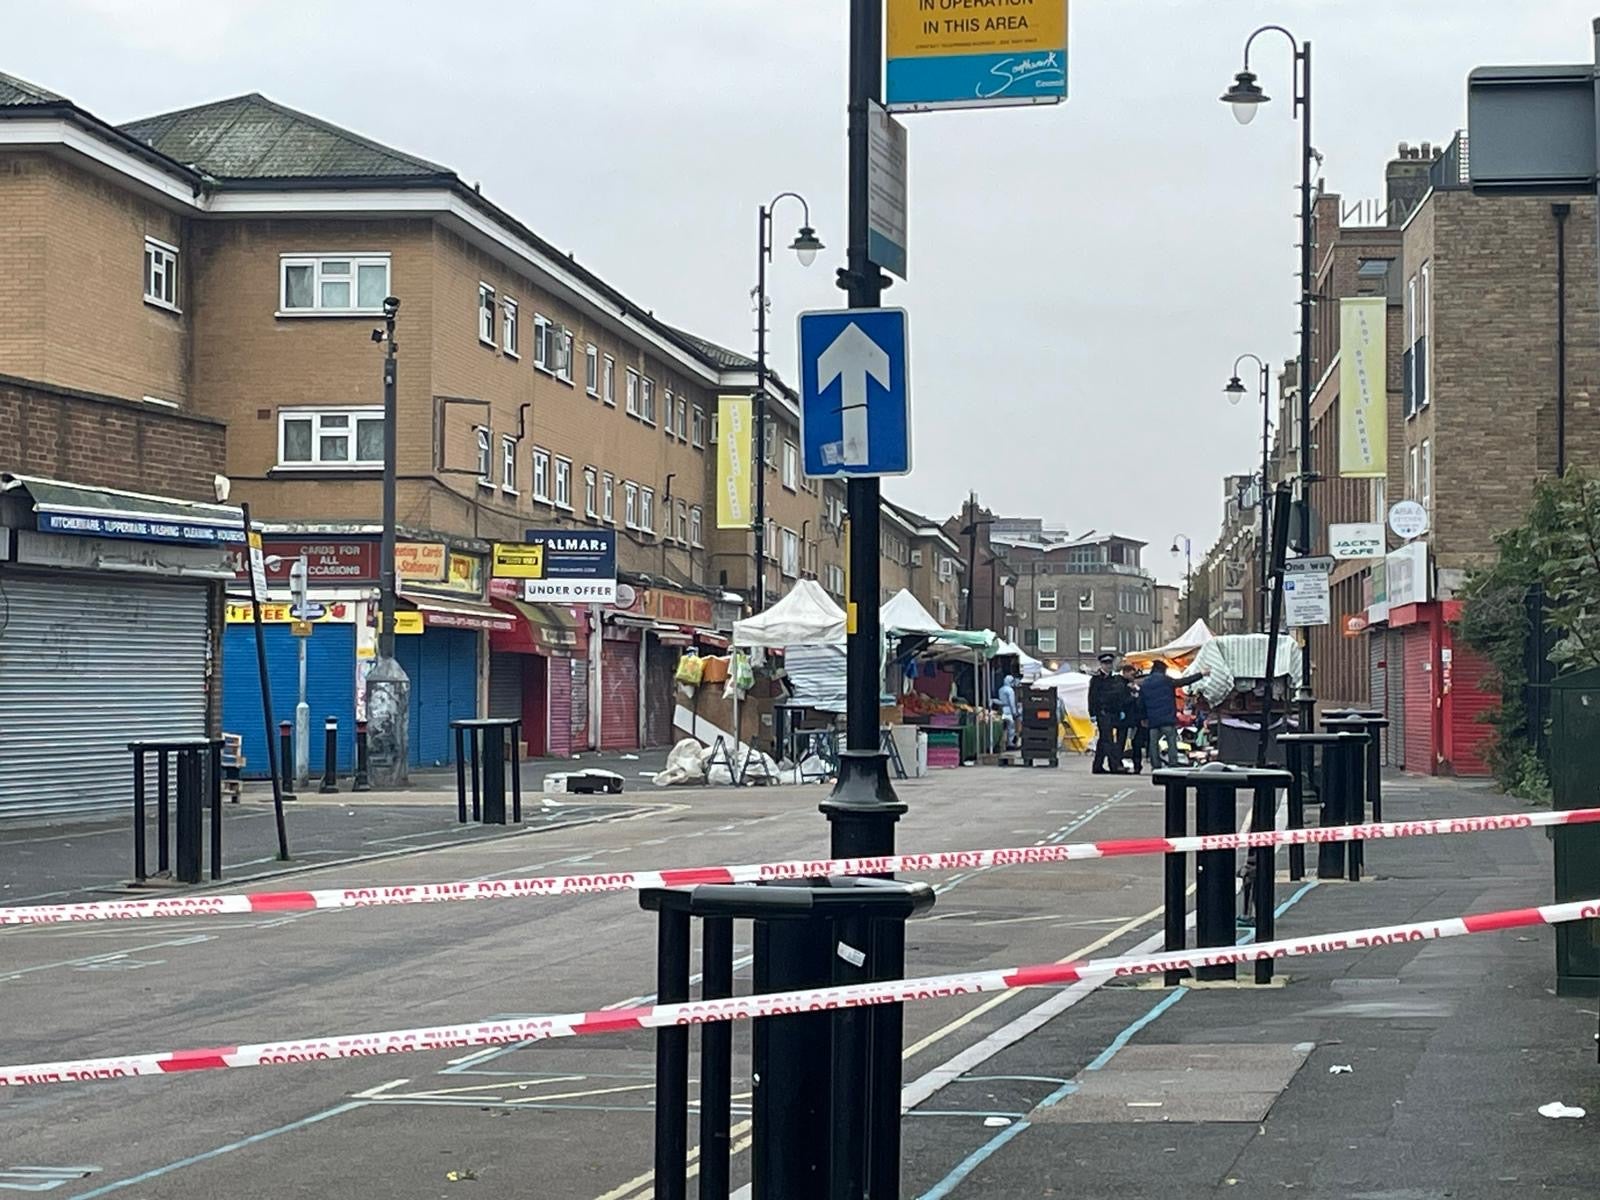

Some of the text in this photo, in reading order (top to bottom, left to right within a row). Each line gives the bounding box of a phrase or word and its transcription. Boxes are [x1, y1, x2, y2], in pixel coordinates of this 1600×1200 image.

[920, 0, 935, 10] IN
[923, 15, 1028, 33] IN THIS AREA
[1333, 539, 1381, 548] JACK'S
[300, 546, 360, 555] CARDS FOR
[319, 556, 340, 565] ALL
[308, 566, 361, 575] CCASIONS
[1285, 562, 1305, 571] One
[528, 586, 570, 595] UNDER
[574, 586, 612, 596] OFFER
[243, 607, 284, 621] FEE
